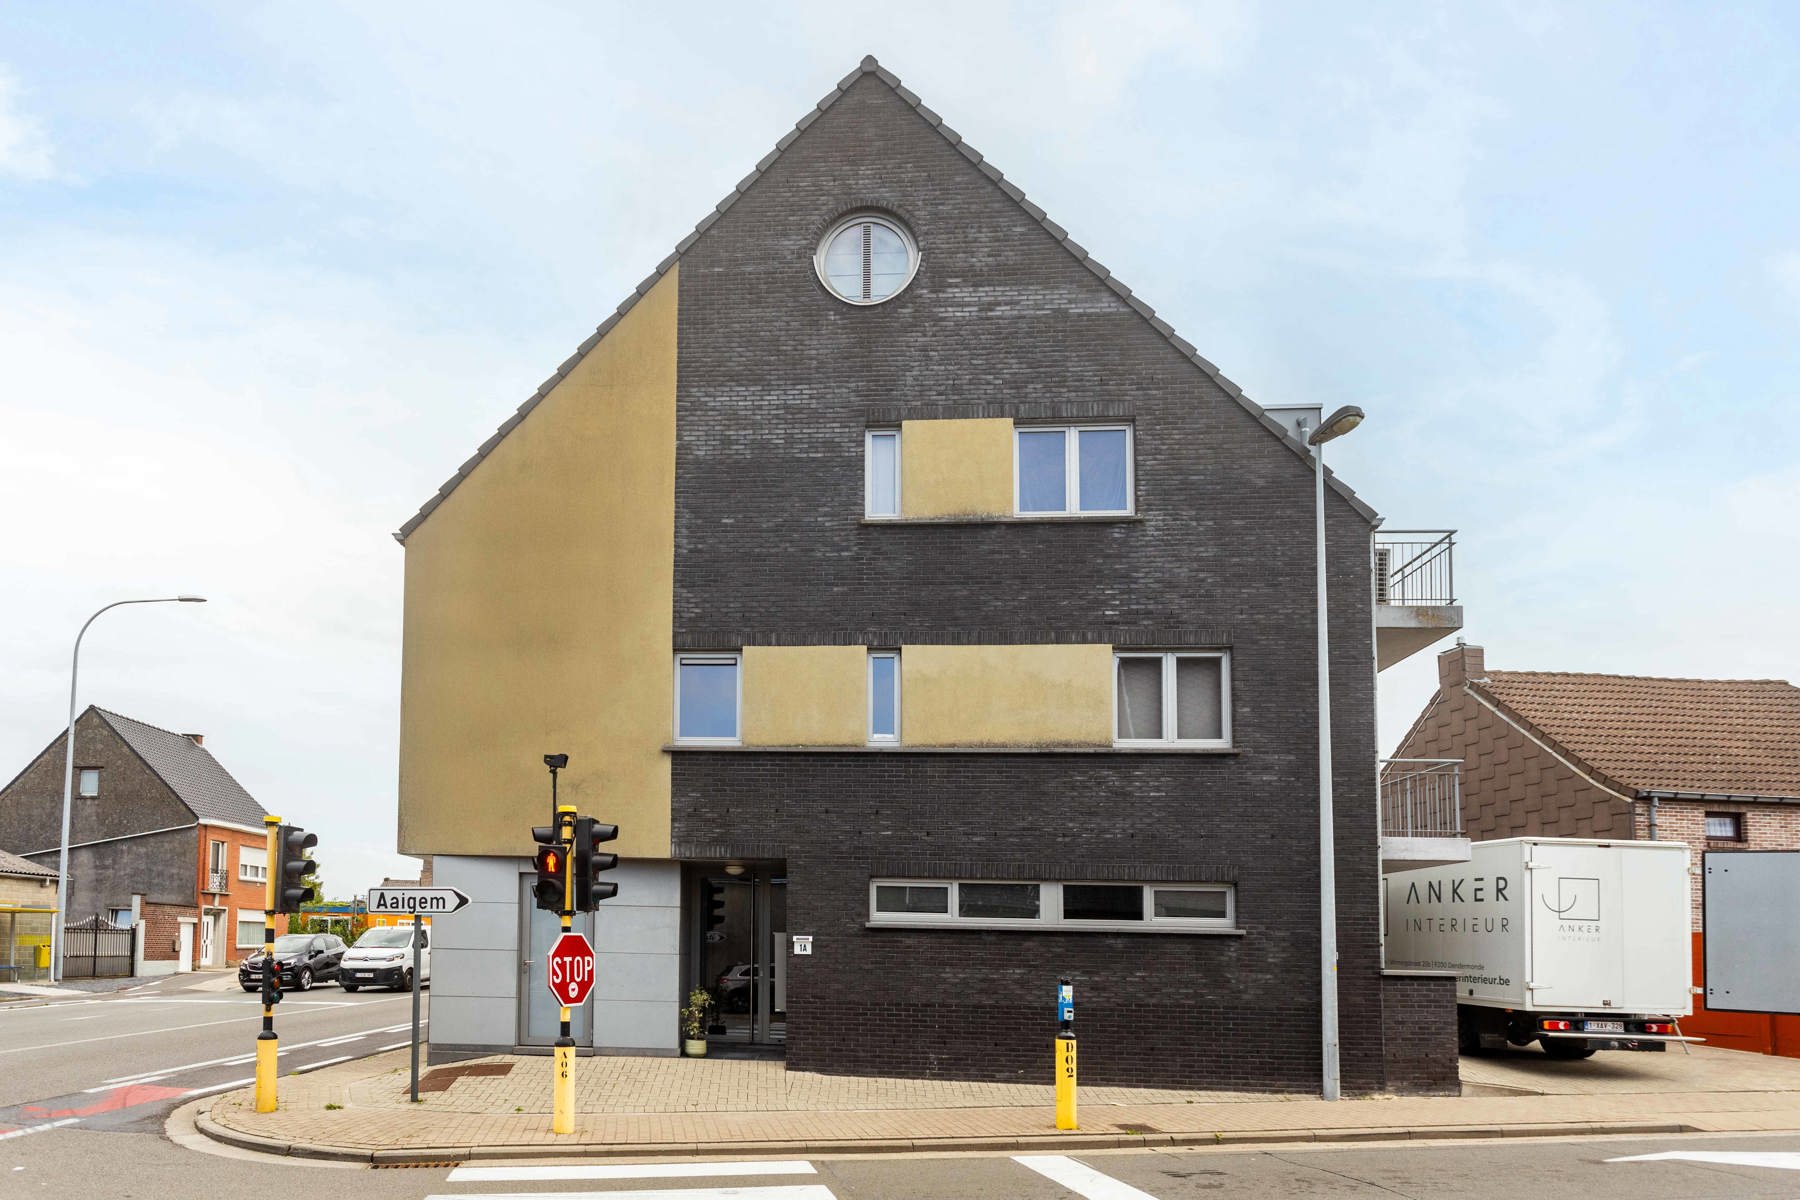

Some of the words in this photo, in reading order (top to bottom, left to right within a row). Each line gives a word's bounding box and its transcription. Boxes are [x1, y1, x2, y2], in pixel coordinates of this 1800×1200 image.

[1406, 876, 1509, 904] ANKER
[376, 892, 446, 914] Aaigem
[1406, 917, 1509, 933] INTERIEUR
[1559, 924, 1600, 933] ANKER
[799, 943, 808, 952] 1A
[552, 956, 593, 984] STOP
